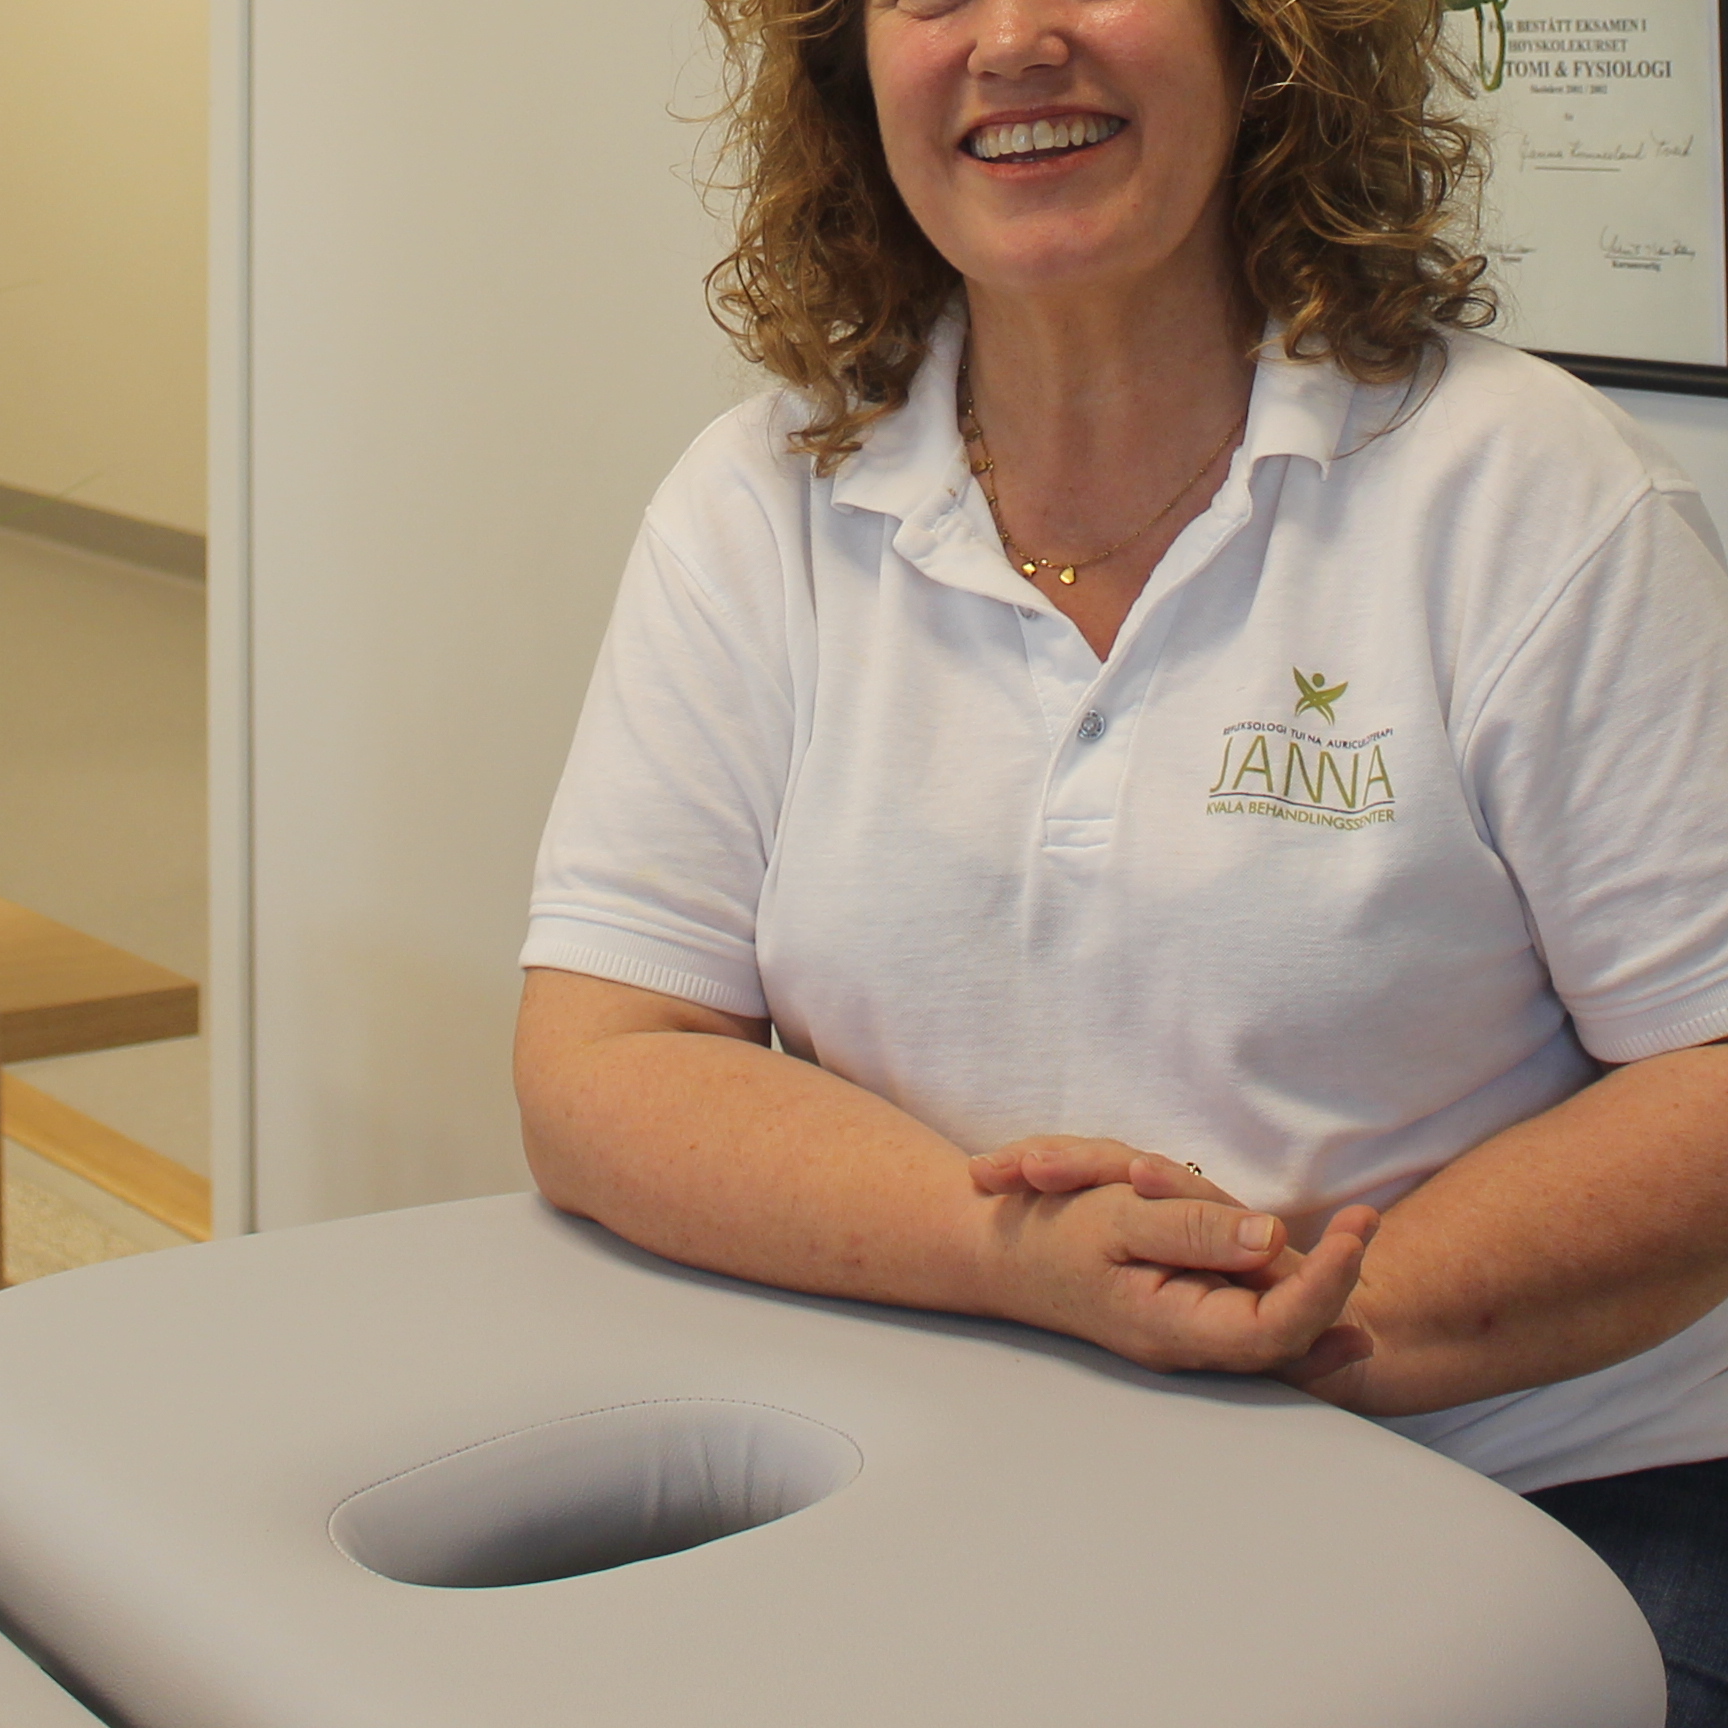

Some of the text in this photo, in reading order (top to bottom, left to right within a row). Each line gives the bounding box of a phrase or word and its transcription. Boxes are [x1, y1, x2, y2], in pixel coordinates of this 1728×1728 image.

[1516, 16, 1571, 33] BESTÅTT
[1575, 19, 1639, 33] EKSAMEN
[1555, 59, 1567, 78] &
[1574, 59, 1672, 79] FYSIOLOGI
[1209, 734, 1394, 809] JANNA
[1206, 800, 1396, 831] KVALA BEHANDLINGSSENTER
